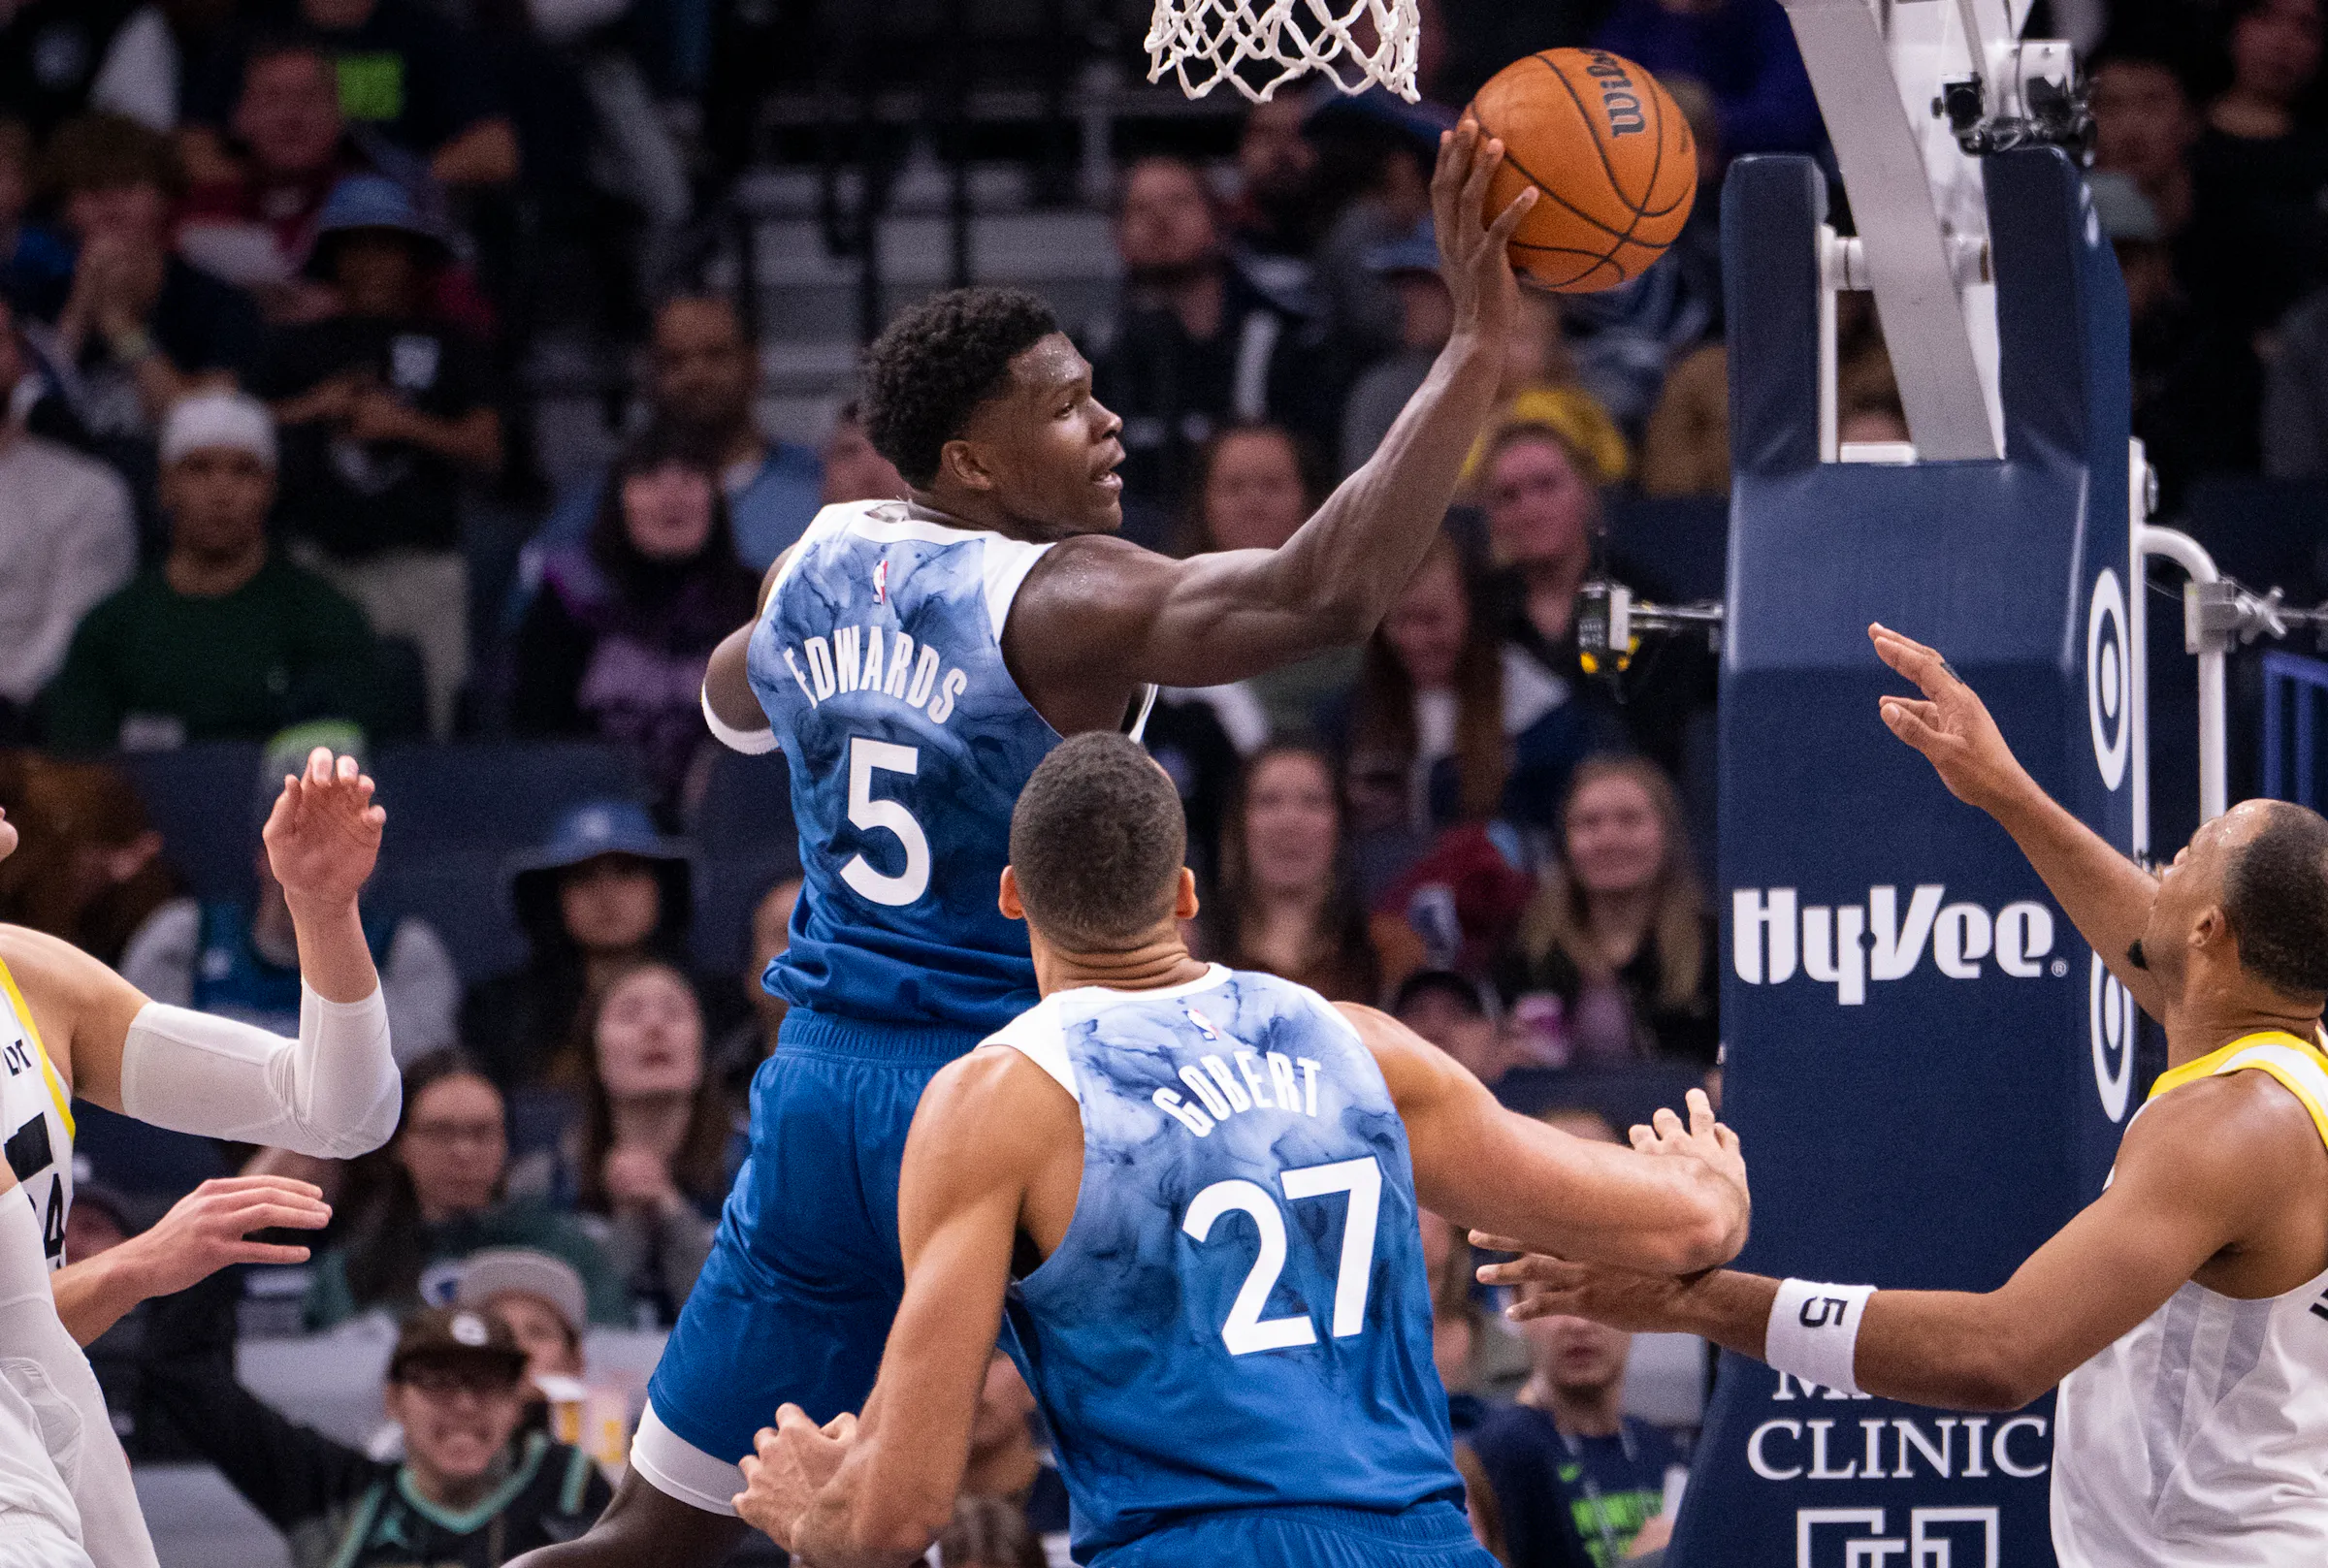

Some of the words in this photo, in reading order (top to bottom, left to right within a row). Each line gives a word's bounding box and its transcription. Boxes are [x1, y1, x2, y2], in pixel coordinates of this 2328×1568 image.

[783, 624, 967, 724] EDWARDS
[840, 737, 931, 907] 5
[1151, 1050, 1321, 1138] GOBERT
[1181, 1156, 1383, 1357] 27
[1798, 1296, 1848, 1328] 5
[1747, 1416, 2048, 1481] CLINIC
